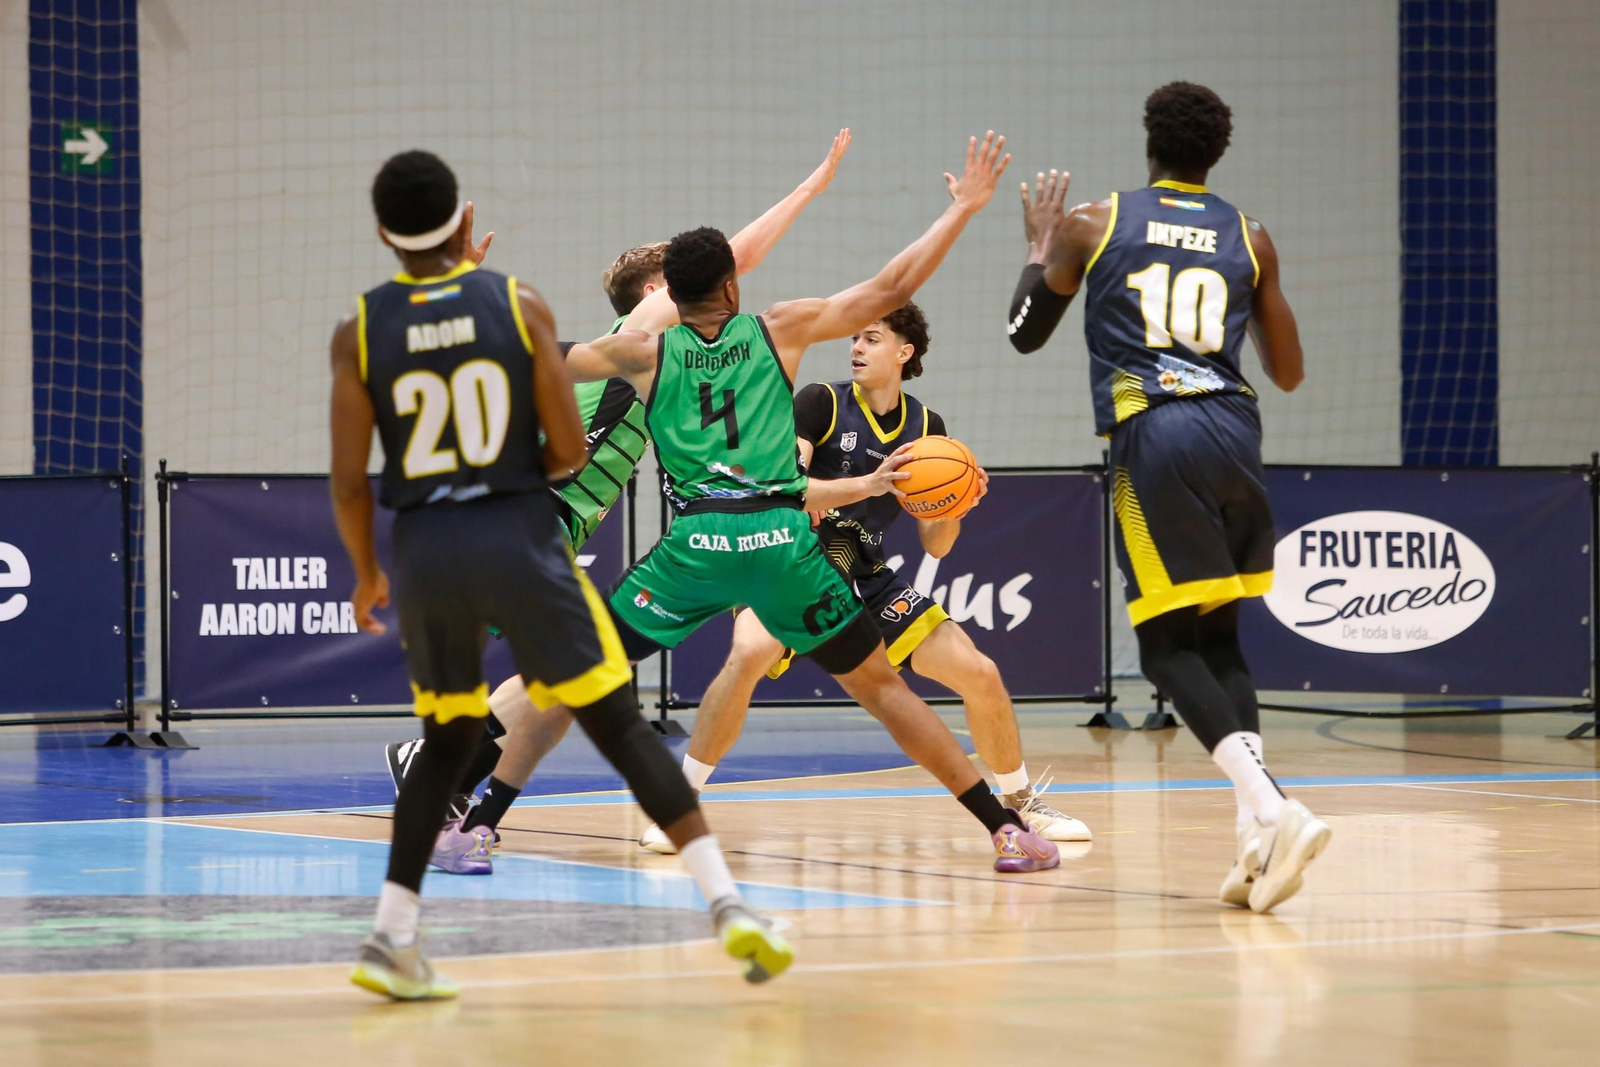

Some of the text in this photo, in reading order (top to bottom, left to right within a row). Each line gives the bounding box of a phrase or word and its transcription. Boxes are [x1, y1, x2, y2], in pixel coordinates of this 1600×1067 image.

[1147, 221, 1217, 253] IKPEZE
[1127, 262, 1228, 355] 10
[407, 316, 476, 353] ADOM
[685, 341, 751, 372] OBIORAH
[392, 358, 511, 480] 20
[699, 382, 740, 450] 4
[903, 492, 957, 513] Wilson
[689, 527, 795, 552] CAJA RURAL
[1299, 530, 1461, 569] FRUTERIA
[232, 556, 328, 590] TALLER
[1294, 570, 1487, 627] Saucedo
[199, 601, 358, 636] AARON CAR
[1342, 624, 1358, 639] De
[1362, 626, 1388, 640] toda
[1392, 626, 1402, 640] la
